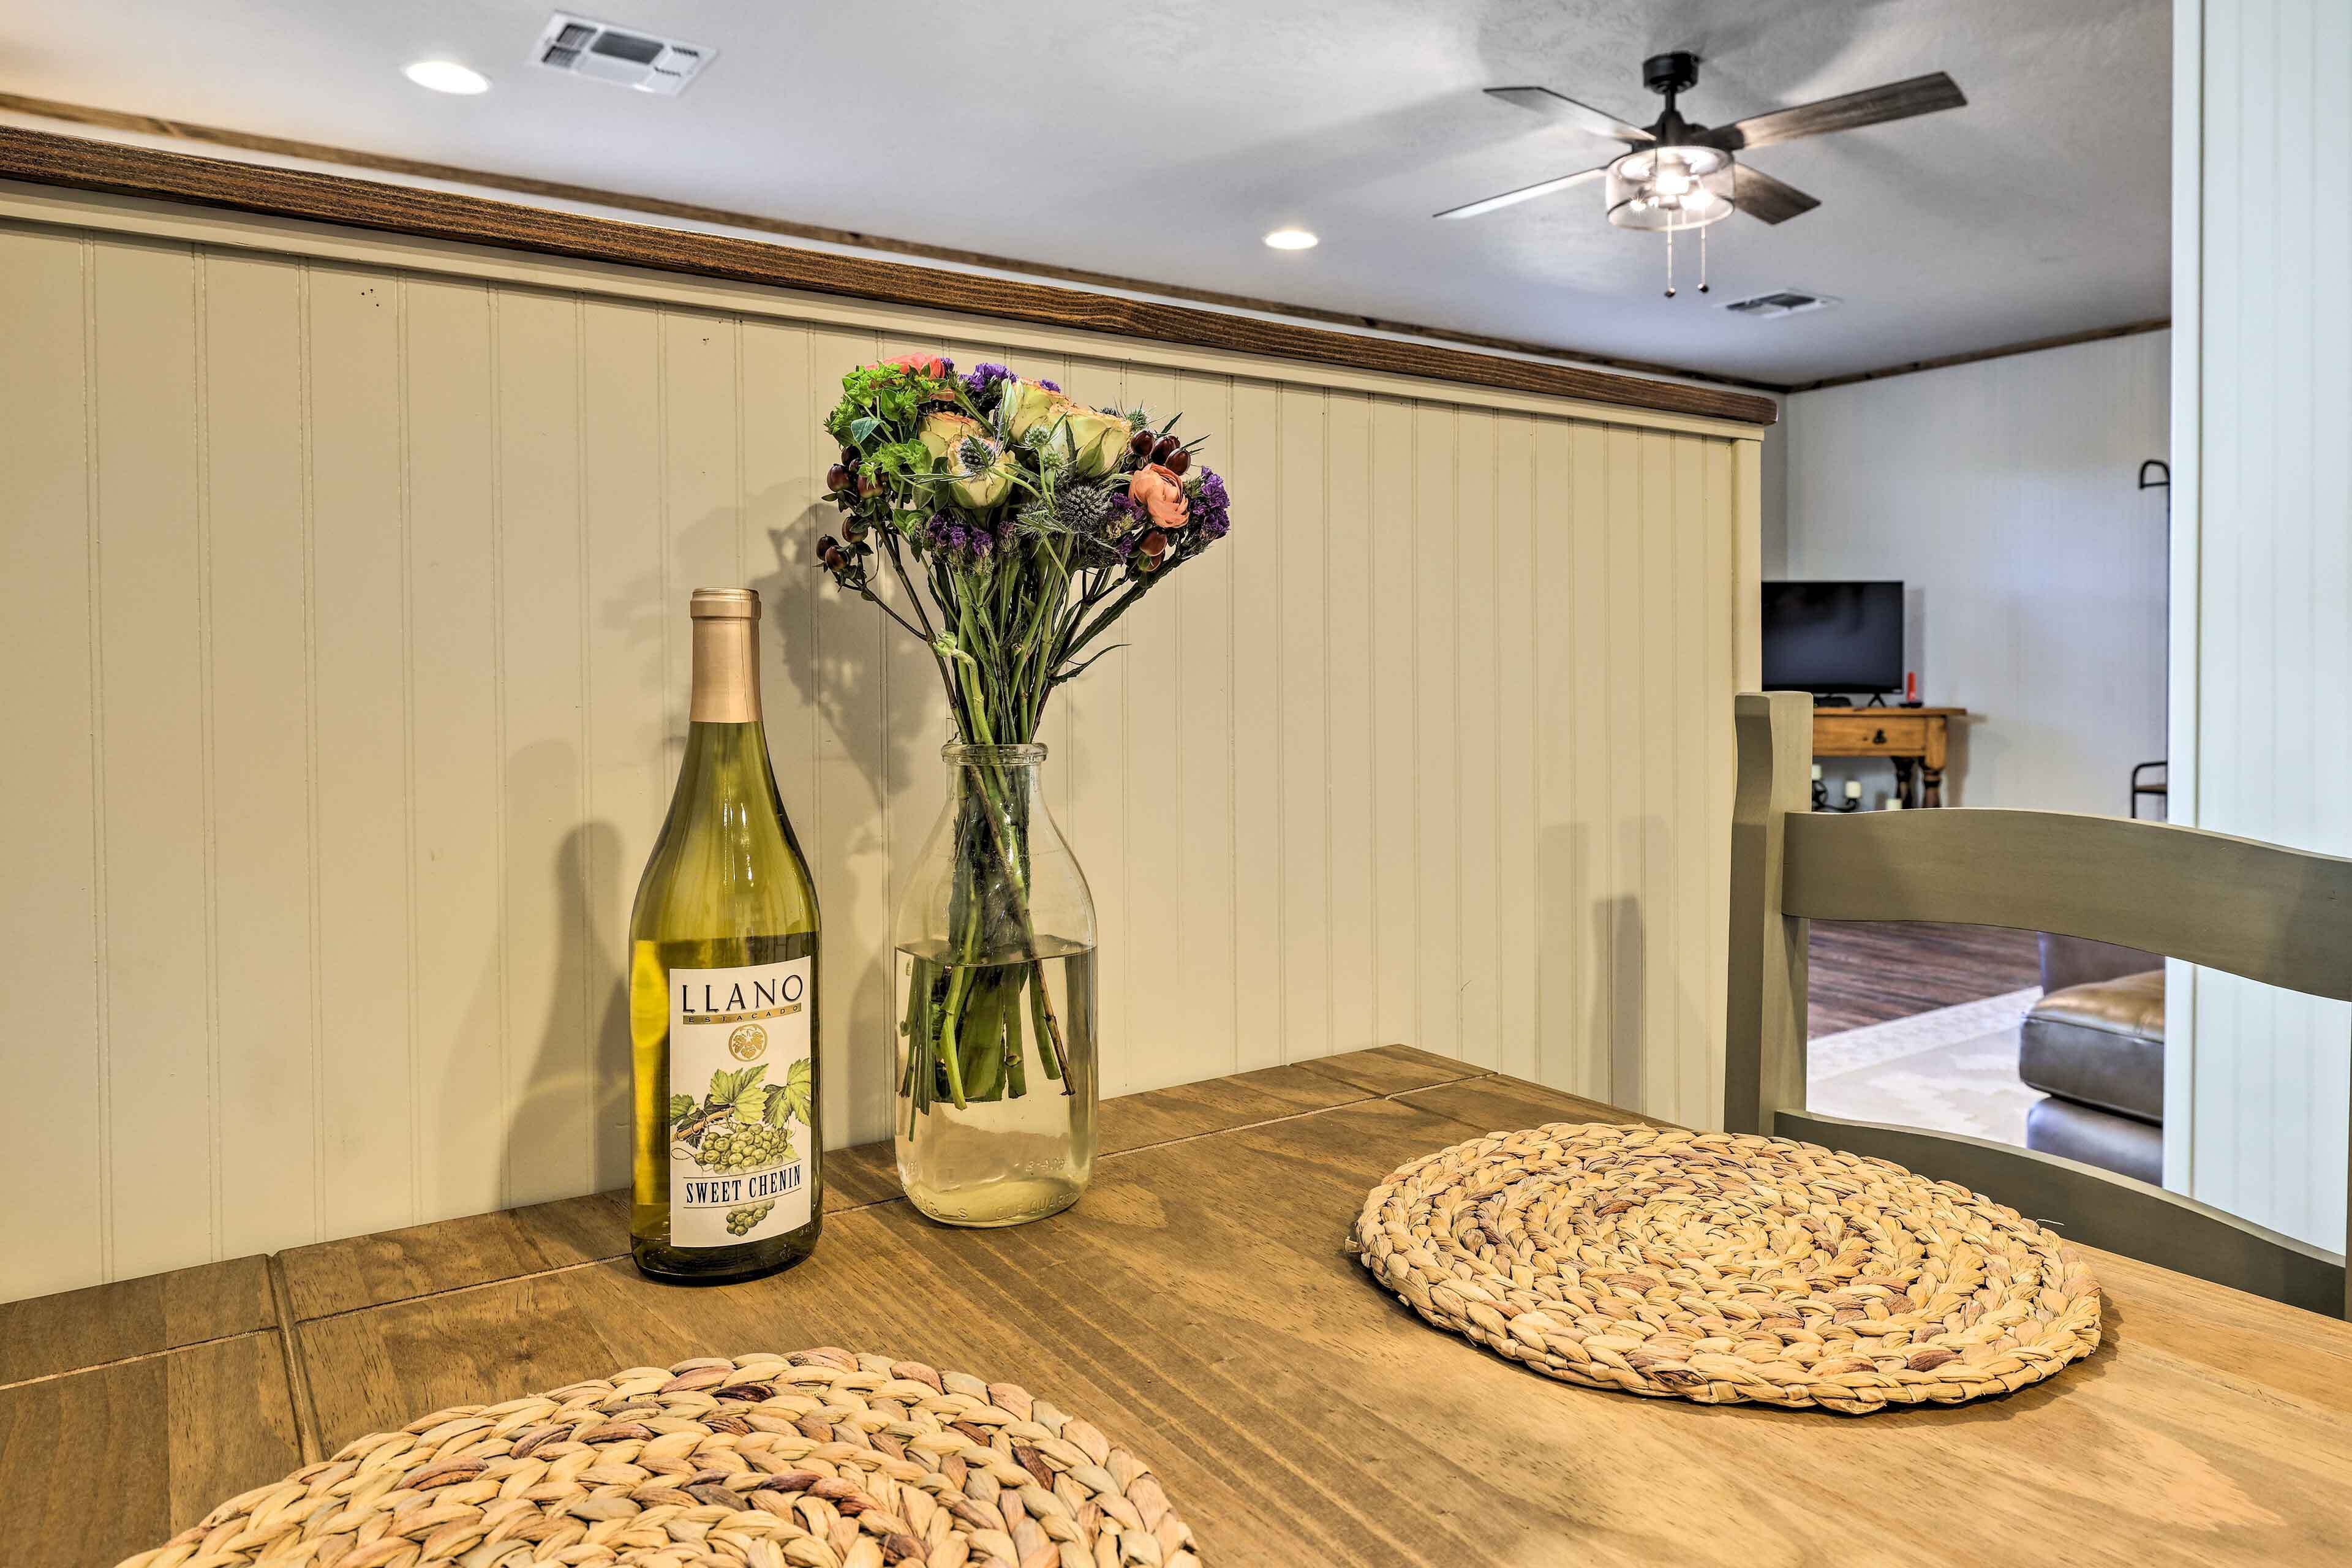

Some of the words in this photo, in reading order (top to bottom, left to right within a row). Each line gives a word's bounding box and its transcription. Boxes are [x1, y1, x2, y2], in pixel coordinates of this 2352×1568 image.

[682, 974, 804, 1014] LLANO
[688, 1005, 799, 1023] ESTACADO
[686, 1179, 742, 1204] SWEET
[748, 1164, 801, 1198] CHENIN
